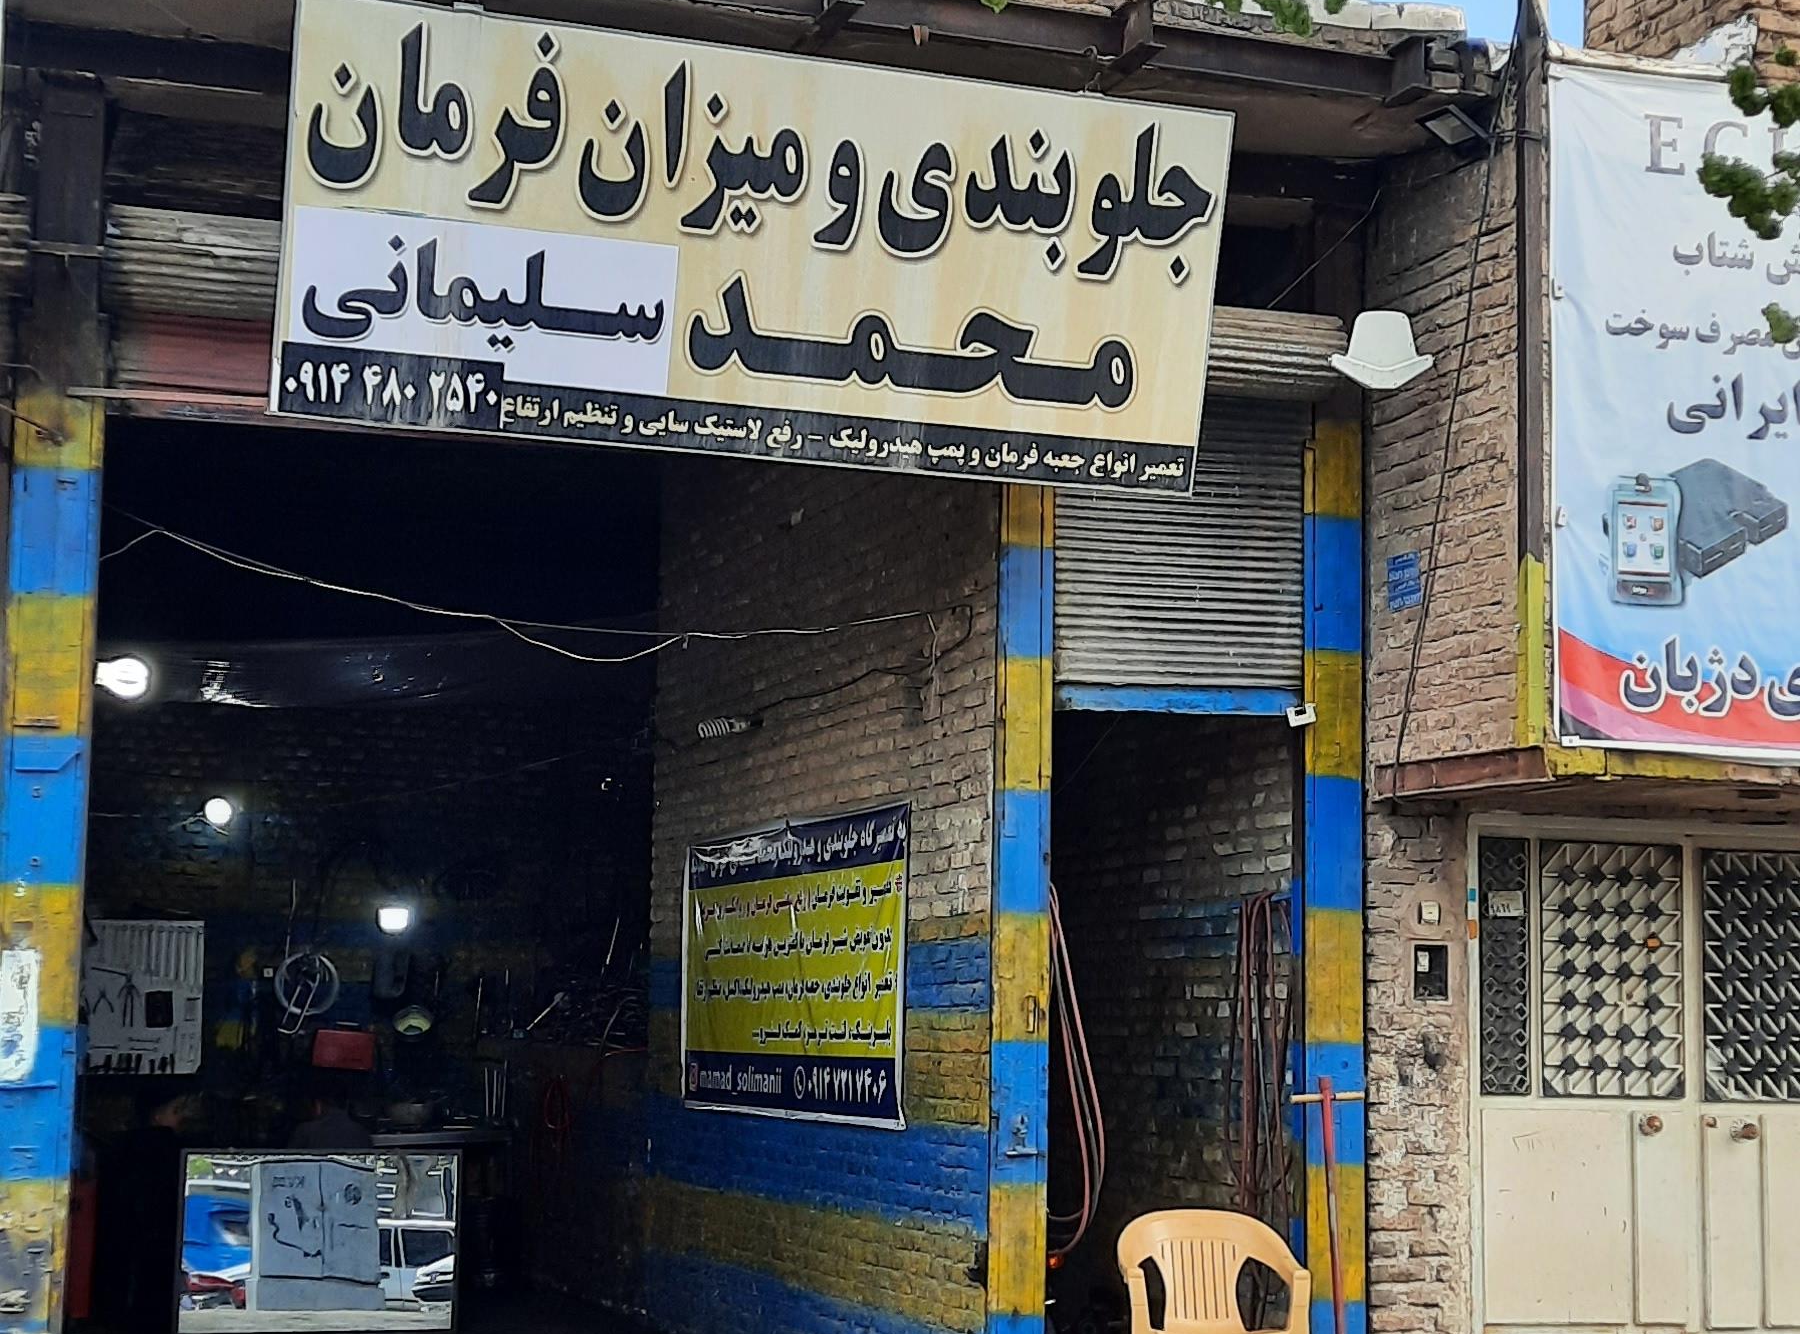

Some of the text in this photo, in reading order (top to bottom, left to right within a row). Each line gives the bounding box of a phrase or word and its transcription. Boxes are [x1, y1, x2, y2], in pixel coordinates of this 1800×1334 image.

[305, 20, 568, 210] فرمان
[578, 57, 808, 235] میزان
[812, 139, 864, 250] و
[1672, 231, 1755, 276] شتاب
[301, 234, 1138, 413] محمد سلیمانی
[1605, 308, 1690, 350] سوخت
[285, 360, 498, 414] ۰۹۱۴ ۴۸۰ ۲۵۴۰
[502, 394, 560, 426] ارتفاع
[562, 401, 620, 428] تنظیم
[621, 413, 633, 434] و
[637, 410, 690, 436] سایی
[692, 415, 763, 441] لاستیک
[766, 419, 803, 450] رفع
[828, 427, 923, 461] هیدرولیک
[926, 443, 965, 466] پمپ
[971, 446, 981, 468] و
[984, 442, 1040, 471] فرمان
[1042, 449, 1085, 475] جعبه
[1088, 452, 1137, 478] انواع
[1138, 456, 1187, 481] تعمیر
[1619, 633, 1760, 718] دژبان
